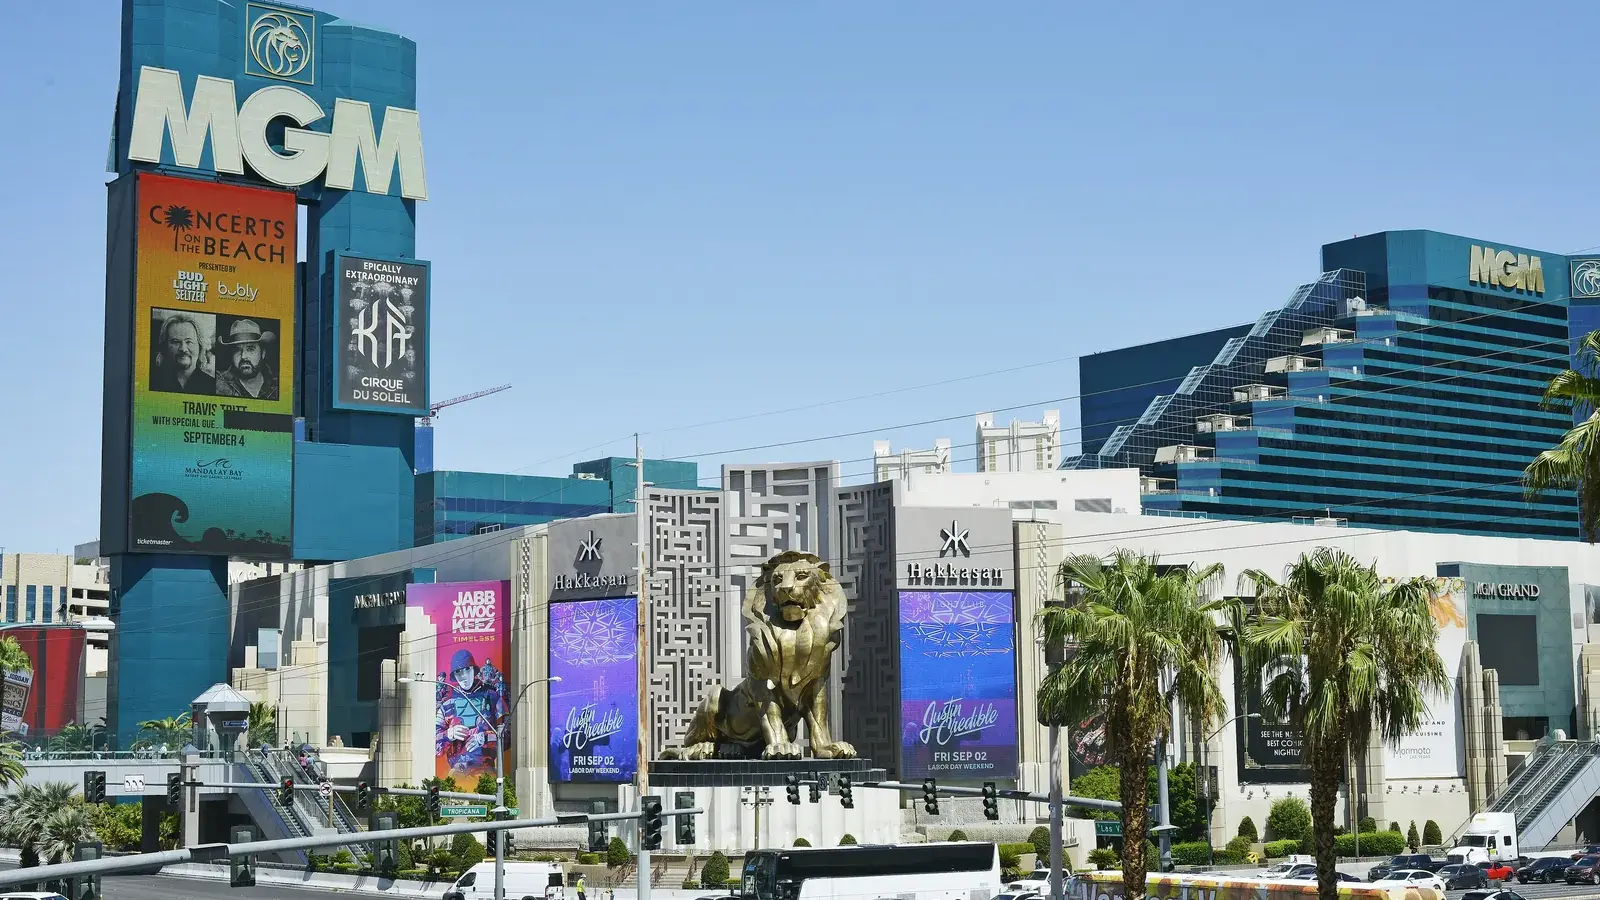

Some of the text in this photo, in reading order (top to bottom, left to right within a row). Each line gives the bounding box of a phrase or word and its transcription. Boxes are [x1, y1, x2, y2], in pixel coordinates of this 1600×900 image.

[128, 65, 427, 199] MGM
[184, 234, 200, 243] ON
[180, 236, 285, 264] THE BEACH
[199, 262, 236, 273] PRESENTED BY
[363, 261, 401, 273] EPICALLY
[1470, 244, 1544, 292] MGM
[178, 270, 204, 282] BUD
[346, 270, 419, 286] EXTRAORDINARY
[173, 279, 209, 292] LIGHT
[218, 281, 258, 302] bubly
[175, 289, 206, 303] SELTZER
[361, 376, 403, 391] CIRQUE
[353, 389, 411, 404] DU SOLEIL
[183, 401, 217, 416] TRAVIS
[152, 416, 171, 426] WITH
[172, 417, 200, 428] SPECIAL
[184, 431, 245, 446] SEPTEMBER 4
[185, 467, 228, 475] MANDALAY
[137, 538, 172, 546] ticketmaster
[908, 563, 1003, 578] Hakkasan
[554, 573, 627, 591] Hakkasan
[1474, 582, 1540, 597] MGM GRAND
[452, 590, 496, 607] JABB
[452, 605, 496, 619] AWOC
[452, 617, 496, 633] KEEZ
[452, 635, 496, 643] TIMELESS
[563, 703, 597, 748] Justin
[920, 697, 963, 744] Justin
[937, 703, 998, 745] Credible
[575, 708, 623, 749] Credible
[573, 755, 614, 765] FRI SEP 02
[934, 751, 987, 761] FRI SEP 02
